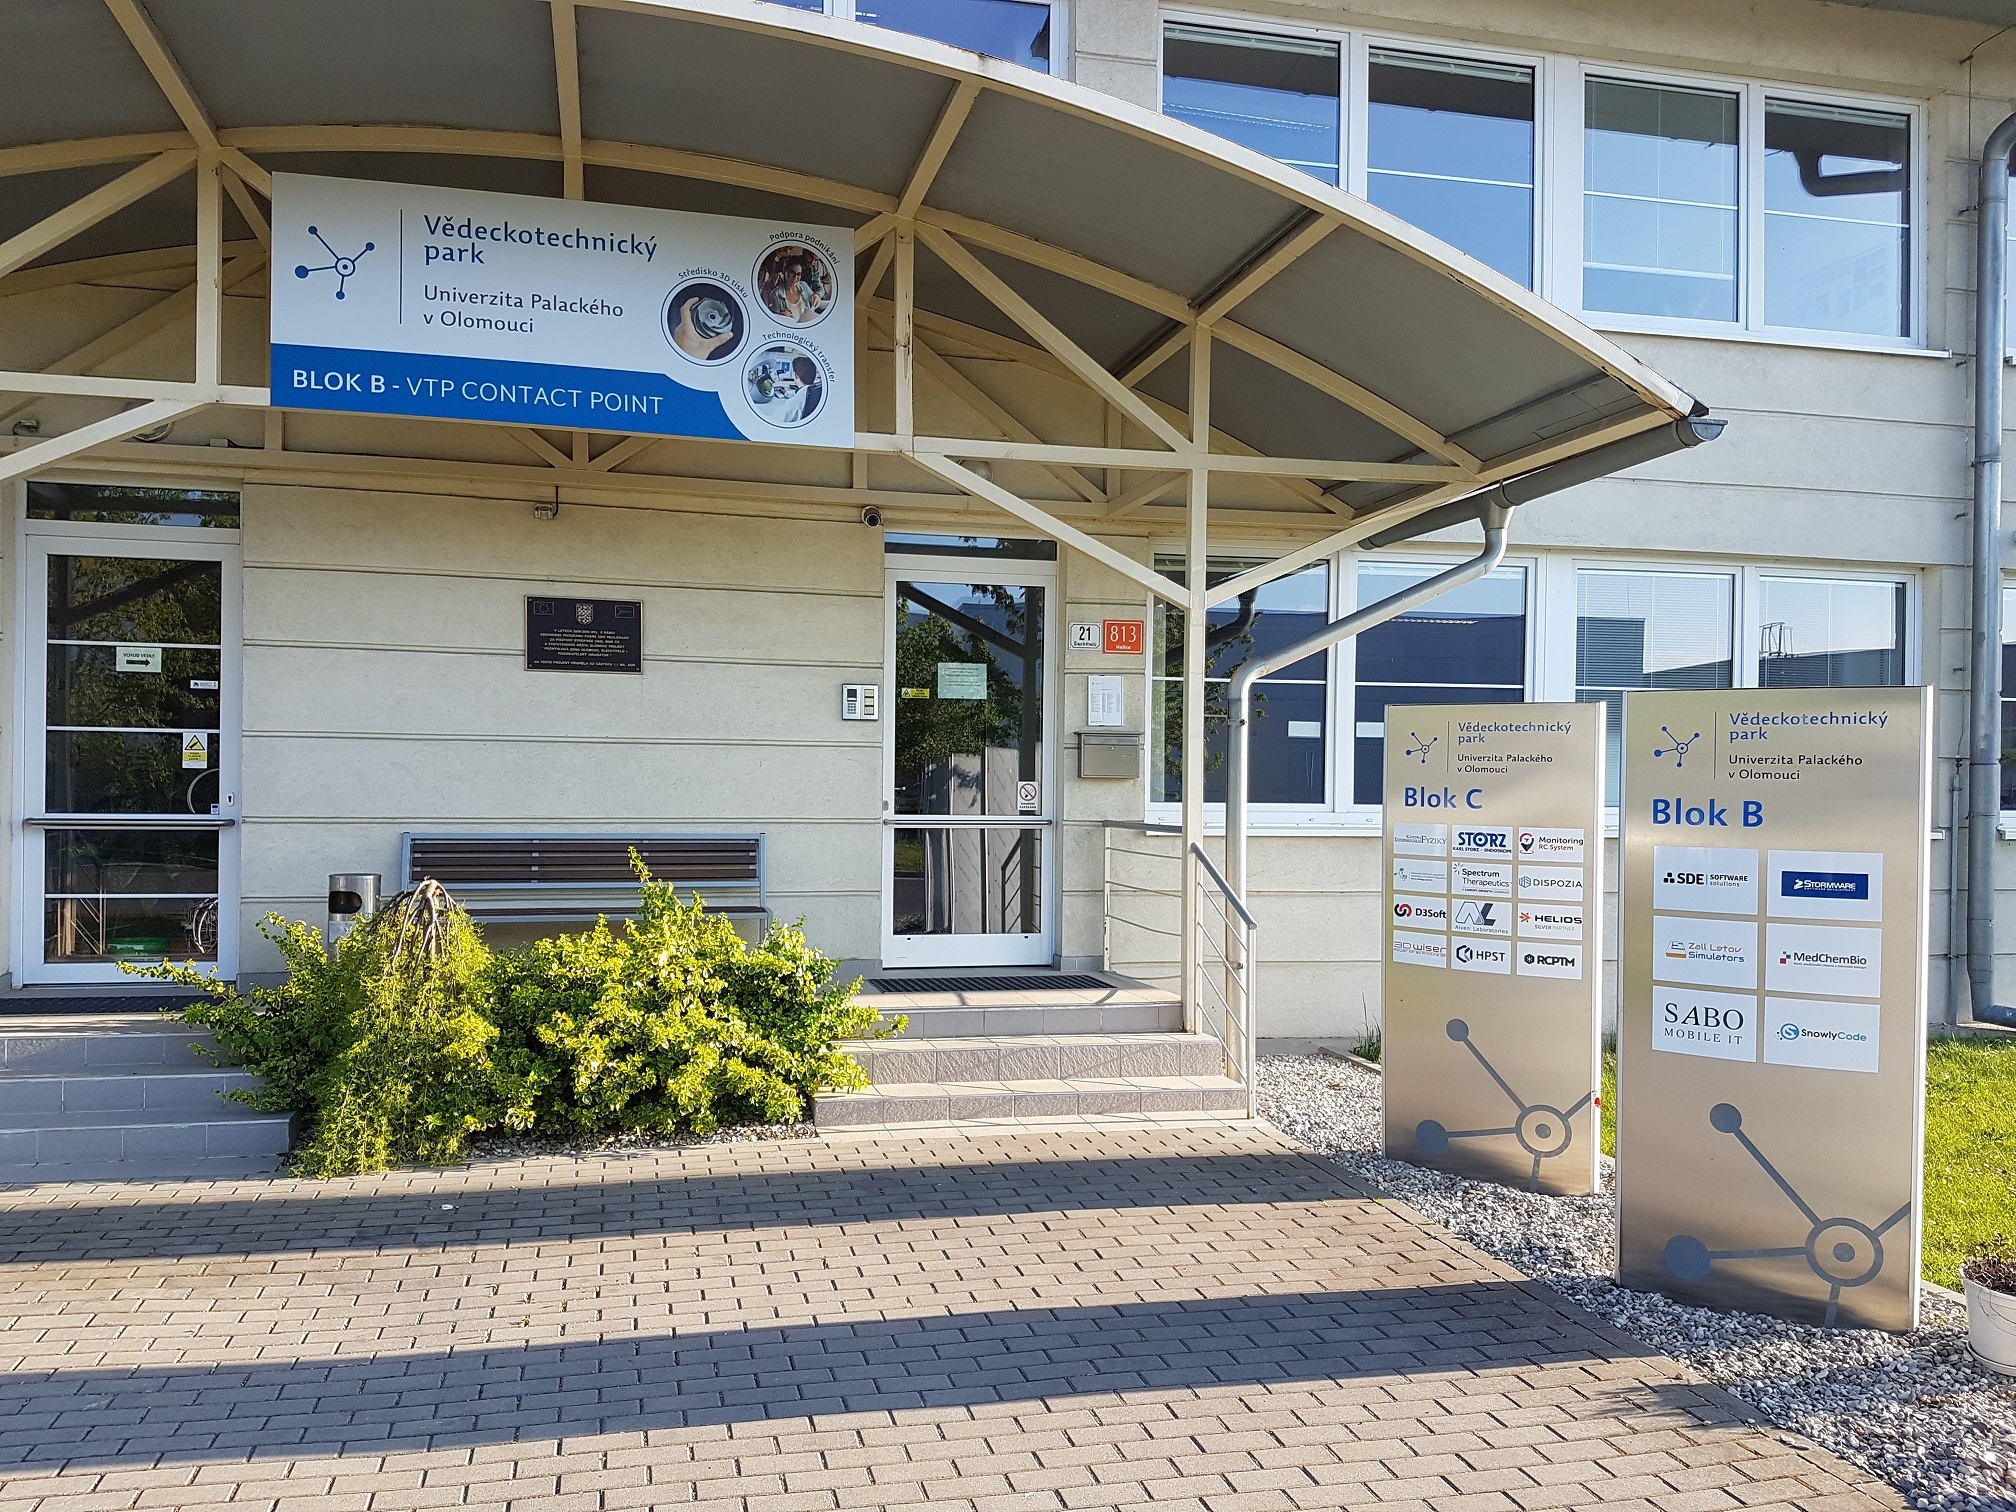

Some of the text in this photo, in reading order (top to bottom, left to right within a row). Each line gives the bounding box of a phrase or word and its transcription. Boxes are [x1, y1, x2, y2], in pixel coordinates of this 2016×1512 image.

[424, 214, 657, 262] Vědeckotechnický
[424, 242, 485, 265] park
[769, 231, 840, 265] Podpora podnikání
[678, 266, 749, 299] Středisko 3D tisku
[424, 284, 623, 317] Univerzita Palackého
[423, 310, 534, 333] v Olomouci
[762, 331, 836, 383] Technologický transfer
[293, 369, 362, 393] BLOK
[371, 374, 386, 394] B
[406, 377, 455, 398] VTP
[462, 381, 583, 408] CONTACT
[590, 391, 664, 415] POINT
[1079, 626, 1091, 641] 21
[1110, 625, 1137, 643] 813
[1729, 711, 1889, 728] Vědeckotechnický
[1458, 721, 1572, 735] Vědeckotechnický
[1729, 727, 1768, 743] park
[1458, 733, 1485, 745] park
[1457, 753, 1553, 763] Univerzita Palackého
[1729, 754, 1863, 766] Univerzita Palackého
[1464, 764, 1508, 774] Olomouci
[1728, 768, 1801, 780] v Olomouci
[1404, 786, 1483, 810] Blok C
[1652, 797, 1764, 828] Blok B
[1458, 831, 1507, 848] STORZ
[1538, 836, 1584, 846] Monitoring
[1461, 868, 1500, 878] Spectrum
[1676, 872, 1704, 885] SDE
[1709, 873, 1749, 882] SOFTWARE
[1461, 877, 1510, 887] Therapeutics
[1533, 878, 1583, 888] DISPOZIA
[1709, 880, 1740, 888] solutions
[1415, 907, 1447, 919] D3Soft
[1534, 914, 1583, 924] HELIOS
[1472, 926, 1509, 934] Laboratories
[1476, 950, 1506, 962] HPST
[1537, 955, 1575, 967] RCPTM
[1688, 951, 1745, 963] Simulators
[1793, 951, 1867, 965] MedChemBio
[1664, 1002, 1744, 1031] SABO
[1664, 1027, 1743, 1045] MOBILE IT
[1801, 1028, 1867, 1042] SnowlyCode
